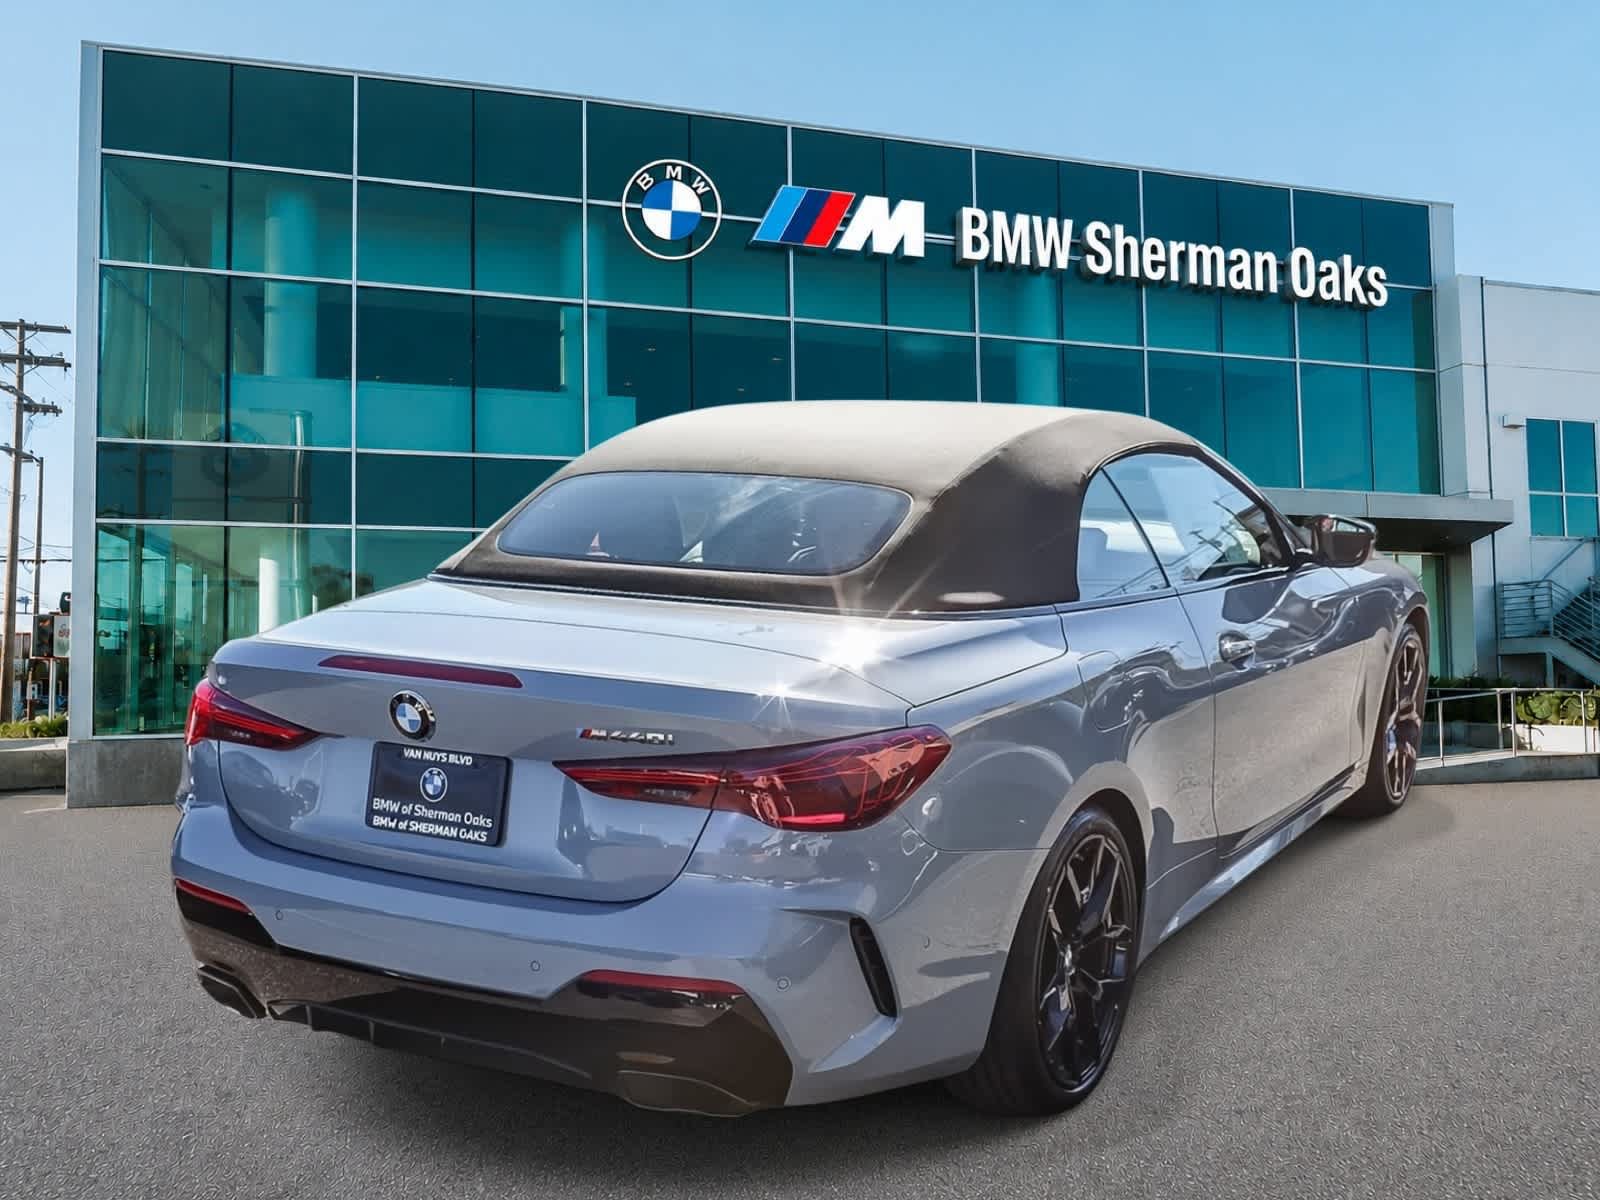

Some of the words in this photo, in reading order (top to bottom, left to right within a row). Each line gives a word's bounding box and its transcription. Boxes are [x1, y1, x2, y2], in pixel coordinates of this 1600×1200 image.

[636, 165, 711, 196] BMW
[960, 206, 1073, 270] BMW
[1084, 220, 1278, 294] Sherman
[1289, 246, 1388, 308] Oaks
[403, 748, 422, 759] VAN
[423, 751, 447, 763] NUYS
[448, 754, 473, 766] BLVD
[372, 798, 400, 813] BMW
[401, 803, 413, 815] of
[413, 804, 462, 823] Sherman
[463, 811, 493, 829] Oaks
[372, 815, 397, 828] BMW
[398, 820, 407, 830] of
[409, 820, 459, 838] SHERMAN
[459, 829, 488, 842] OAKS
